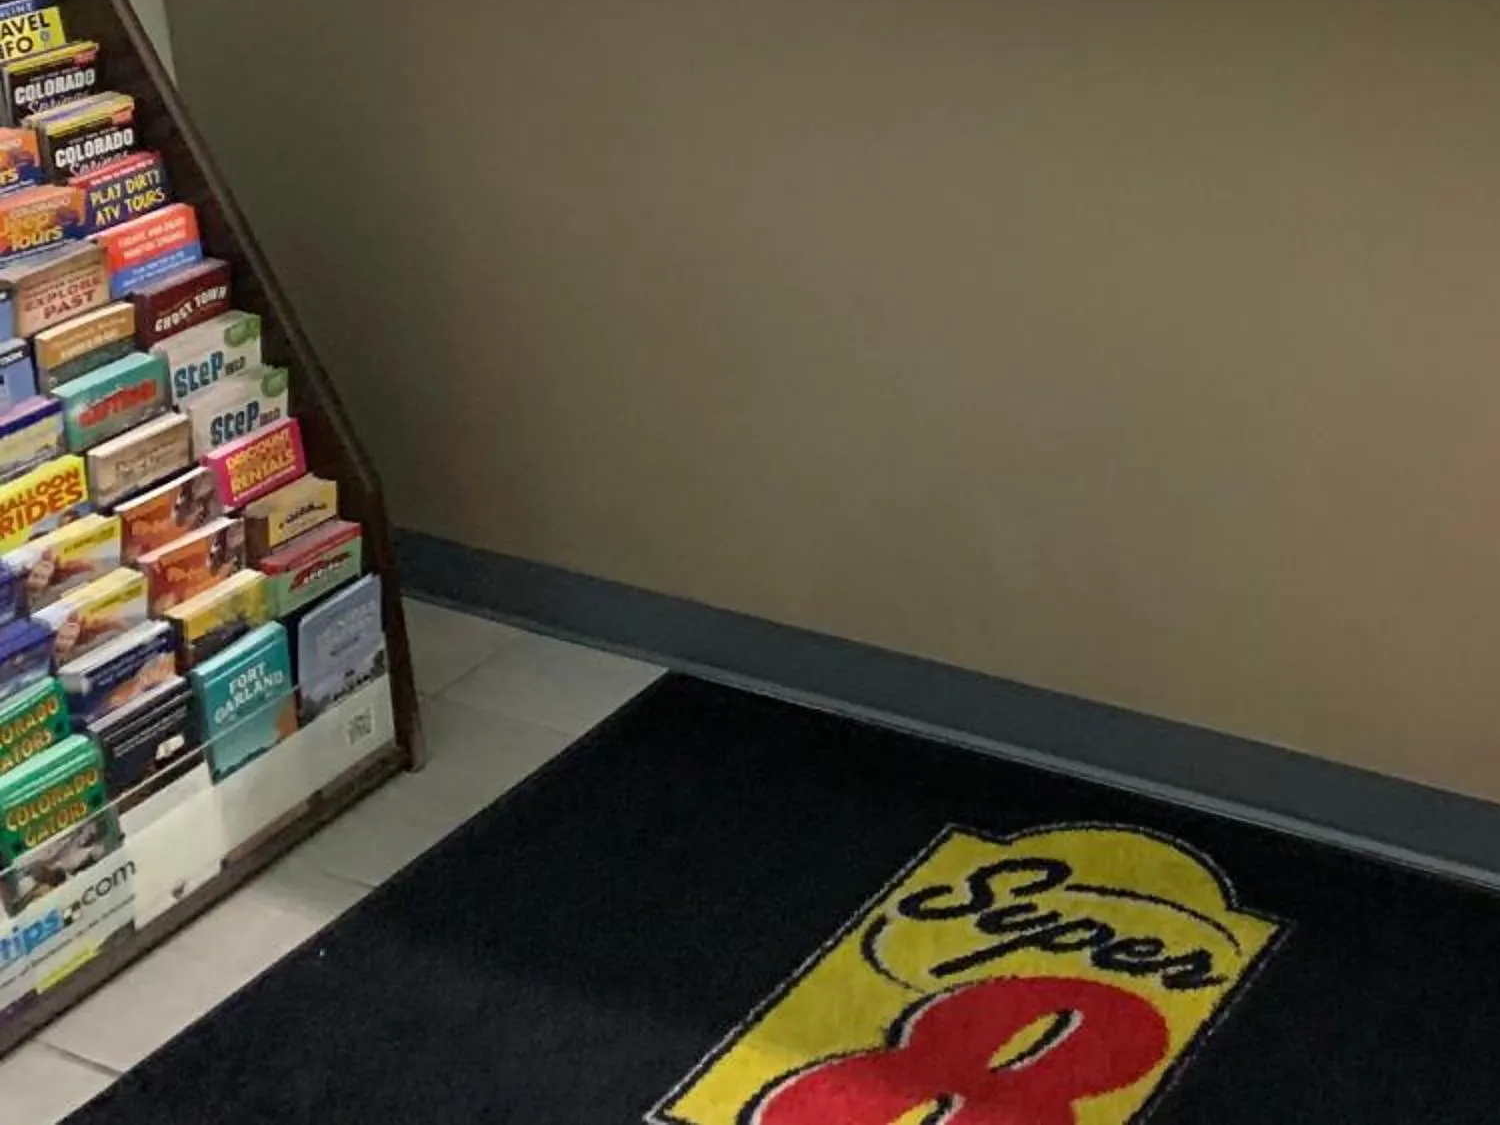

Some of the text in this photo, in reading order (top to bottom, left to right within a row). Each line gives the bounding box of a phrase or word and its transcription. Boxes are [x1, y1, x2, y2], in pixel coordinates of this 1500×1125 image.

[0, 13, 51, 40] AVEL
[0, 35, 34, 59] FO
[14, 68, 96, 106] COLORADO
[55, 128, 134, 168] COLORADO
[90, 169, 160, 207] PLAY DIRTY
[95, 187, 166, 227] ATV TOURS
[43, 288, 96, 320] PAST
[155, 285, 227, 332] GHOST TOWN
[214, 670, 284, 724] GARLAND
[229, 661, 266, 696] FORT
[0, 696, 59, 745] ORADO
[6, 769, 98, 831] COLORADO
[899, 857, 1230, 991] Super
